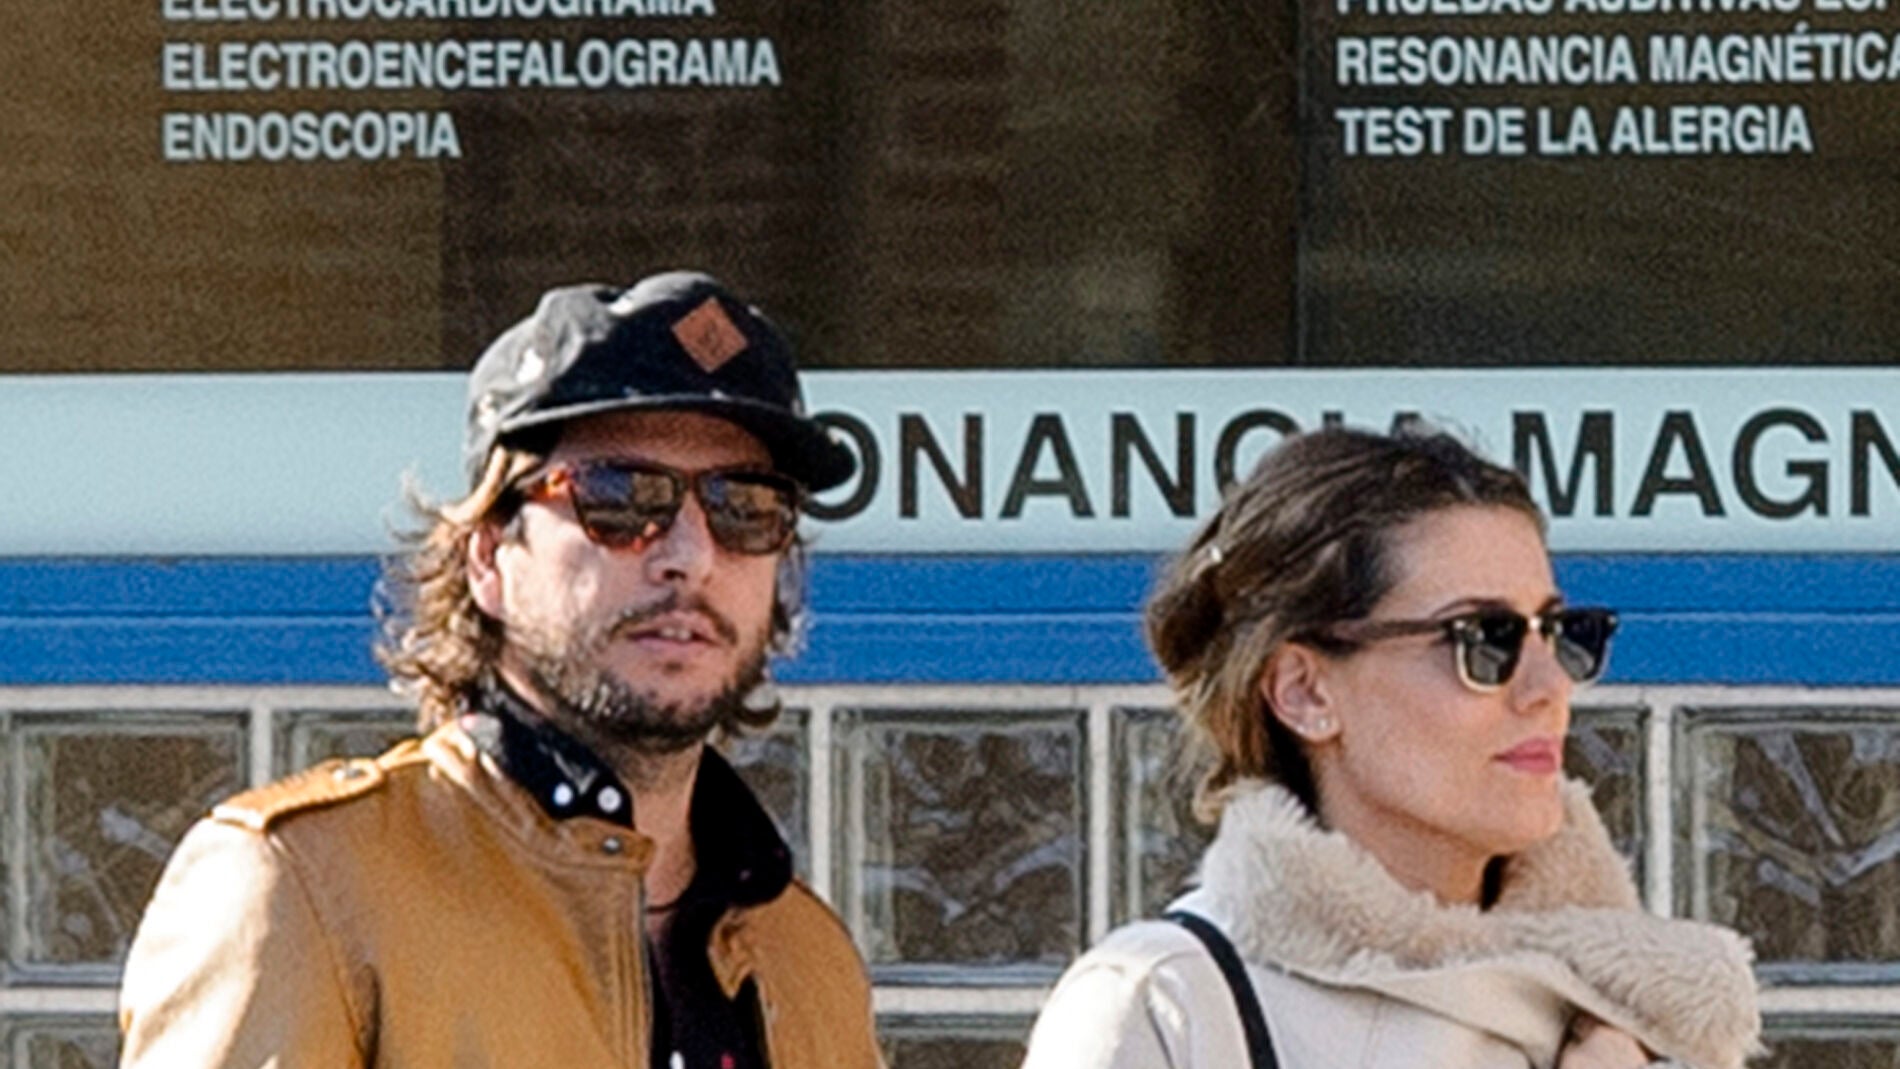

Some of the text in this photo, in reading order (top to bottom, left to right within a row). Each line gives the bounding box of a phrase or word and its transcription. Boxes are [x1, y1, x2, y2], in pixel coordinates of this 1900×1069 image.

[163, 39, 780, 90] ELECTROENCEFALOGRAMA
[1337, 36, 1638, 85] RESONANCIA
[163, 111, 461, 161] ENDOSCOPIA
[1336, 105, 1813, 155] TEST DE LA ALERGIA
